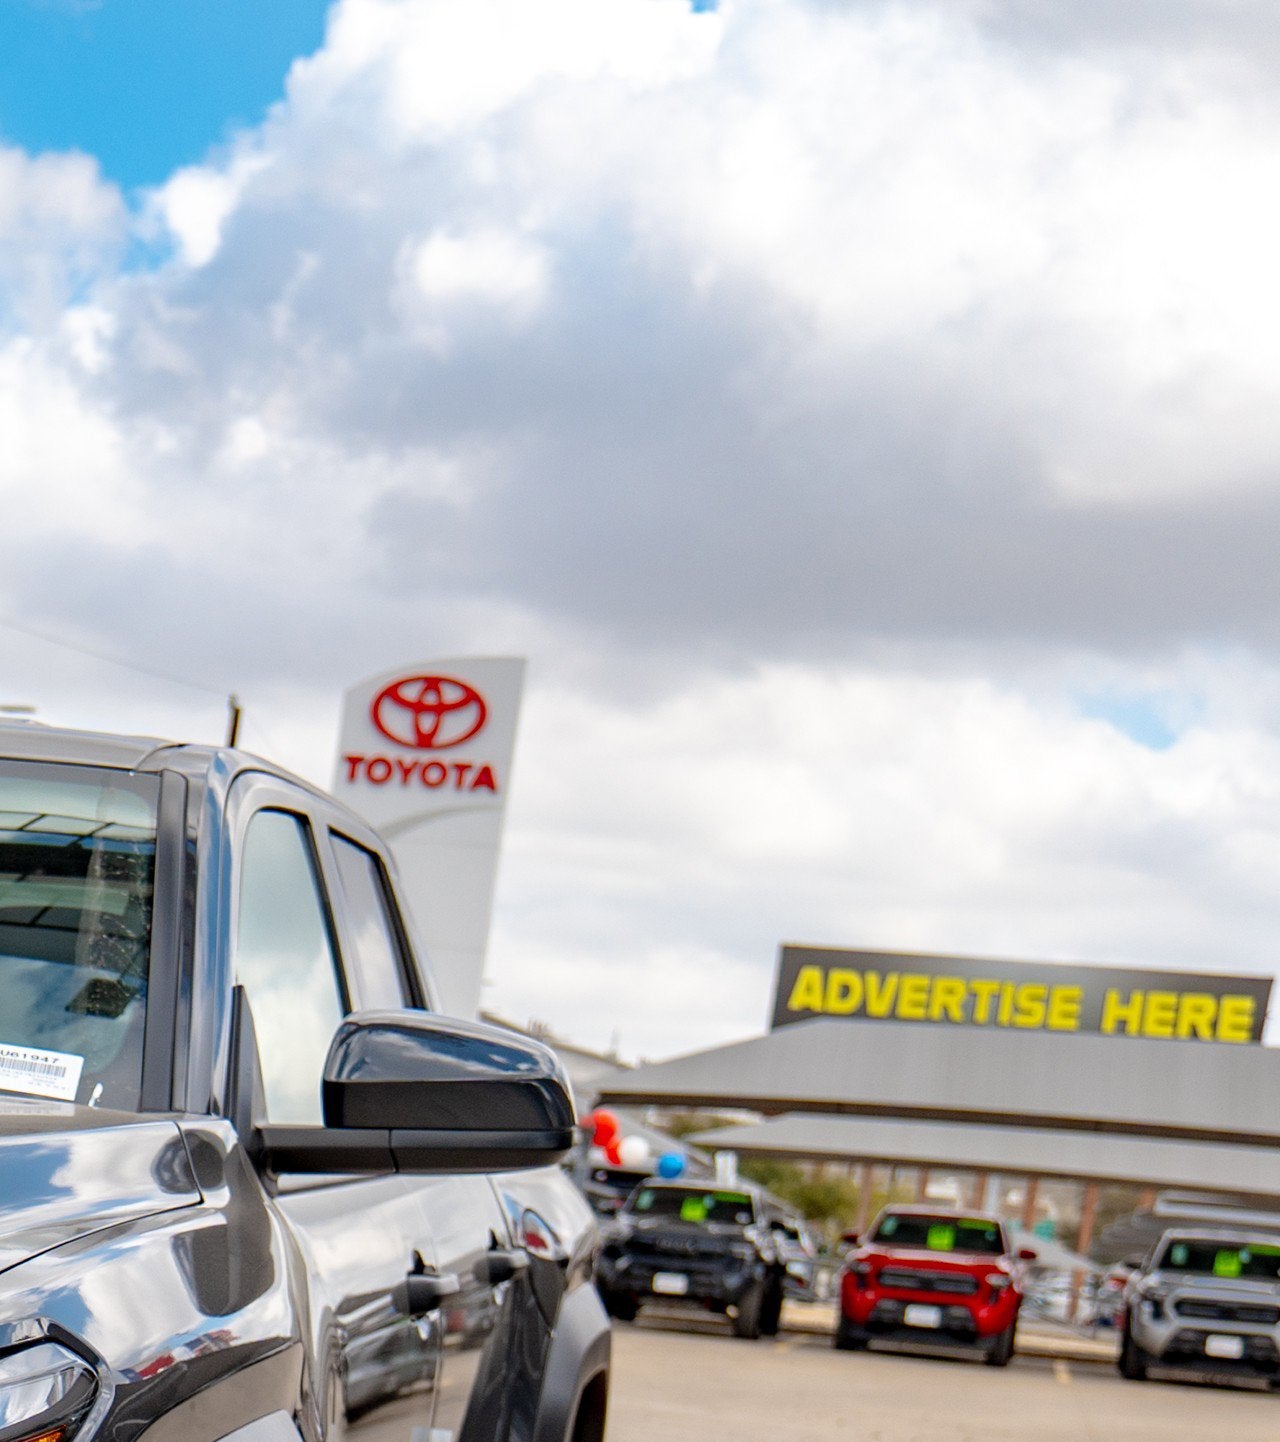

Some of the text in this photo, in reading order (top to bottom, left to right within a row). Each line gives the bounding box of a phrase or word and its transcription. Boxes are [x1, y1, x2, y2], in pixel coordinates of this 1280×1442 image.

[344, 755, 497, 794] TOYOTA
[787, 965, 1256, 1044] ADVERTISE HERE
